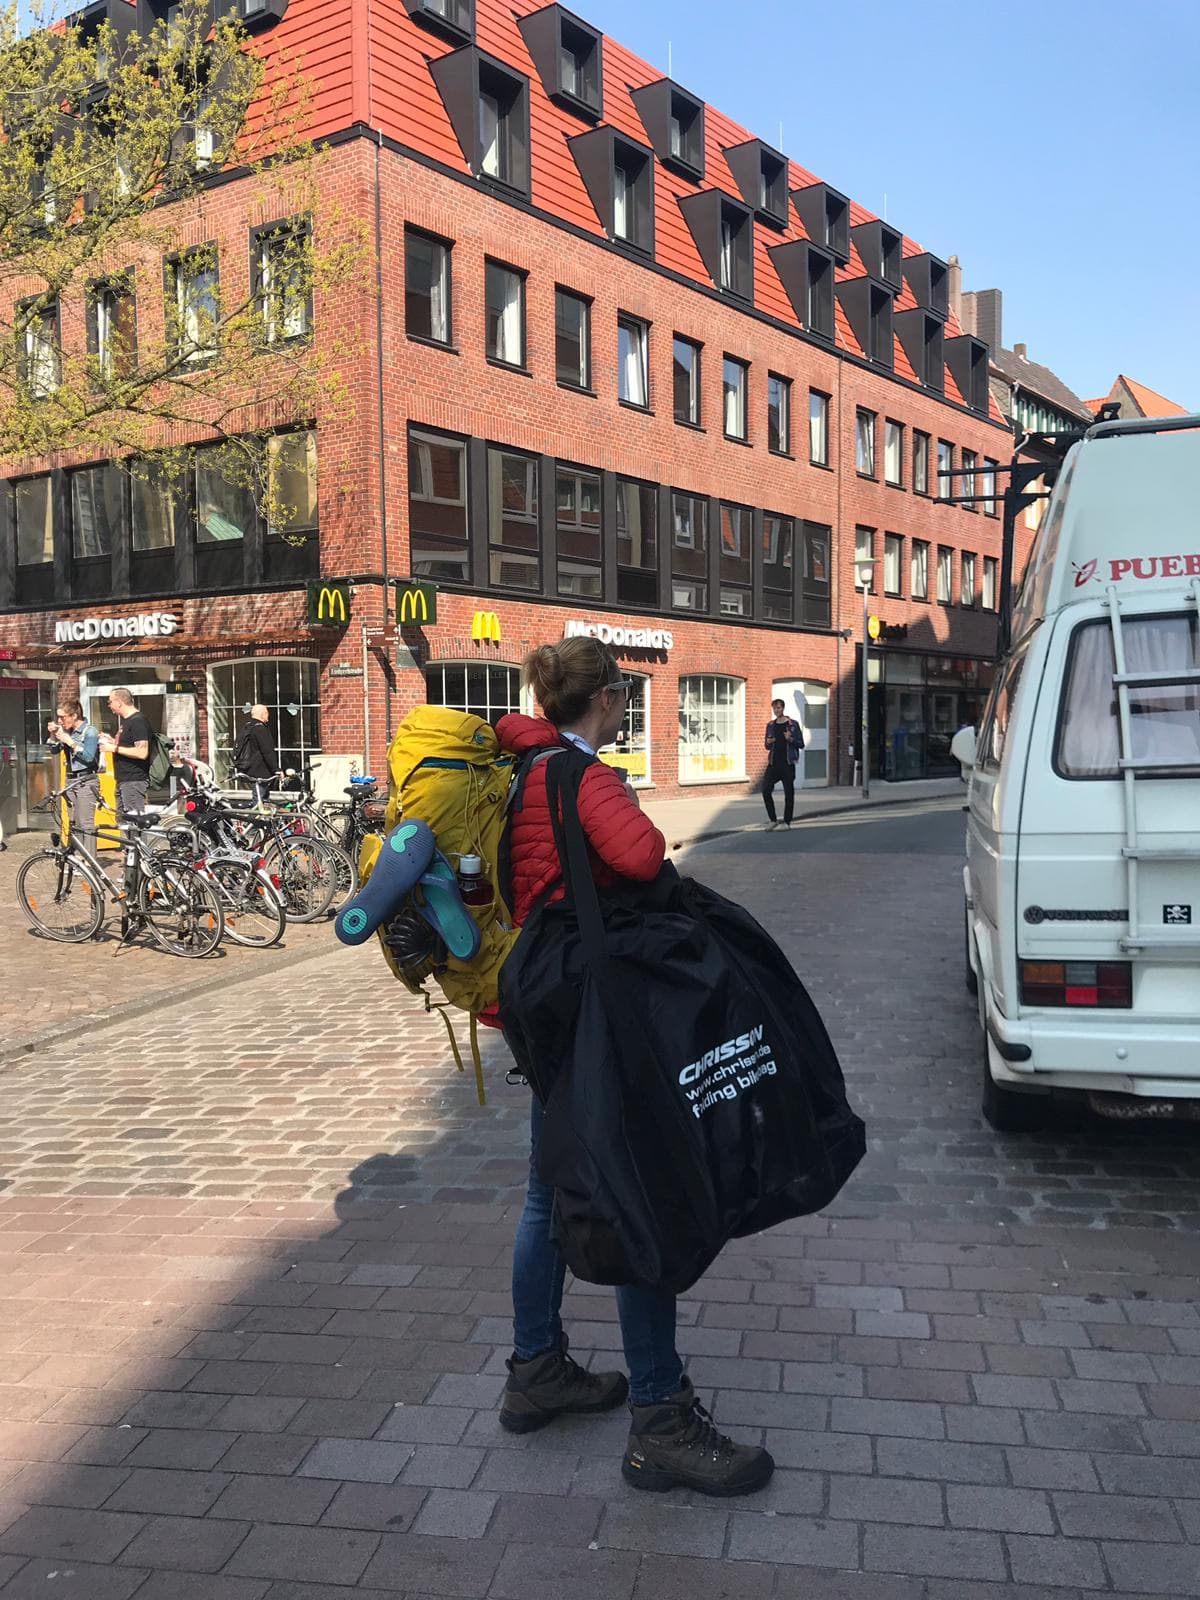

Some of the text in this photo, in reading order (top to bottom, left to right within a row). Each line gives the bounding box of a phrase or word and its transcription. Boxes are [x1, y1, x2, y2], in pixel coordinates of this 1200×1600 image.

[1108, 555, 1200, 581] PUEB
[55, 612, 177, 643] McDonald's
[564, 620, 674, 650] McDonald's
[1045, 909, 1129, 921] VOLKSWAGE
